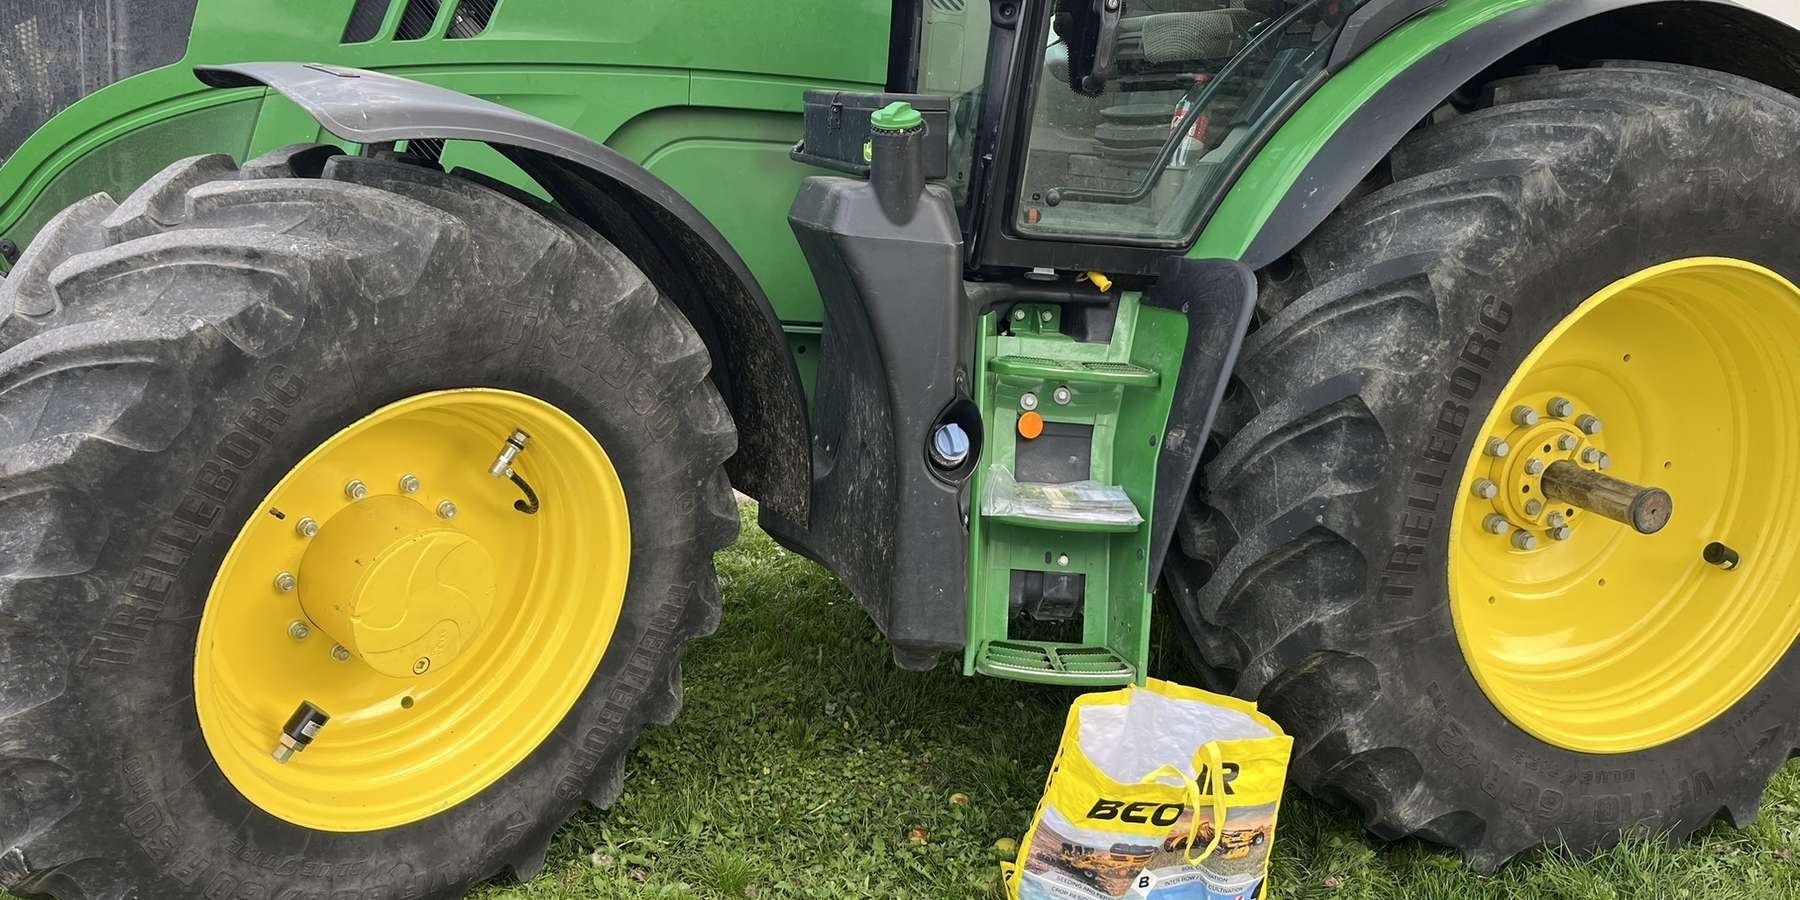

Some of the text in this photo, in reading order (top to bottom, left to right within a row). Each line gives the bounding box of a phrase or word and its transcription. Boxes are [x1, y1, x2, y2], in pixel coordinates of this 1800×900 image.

[77, 363, 307, 673] TRELLEBORG
[1378, 294, 1512, 601] TRELLEBORG
[555, 580, 697, 800] TRELLEBORG
[1056, 875, 1082, 889] SEEDING
[1138, 876, 1149, 888] B
